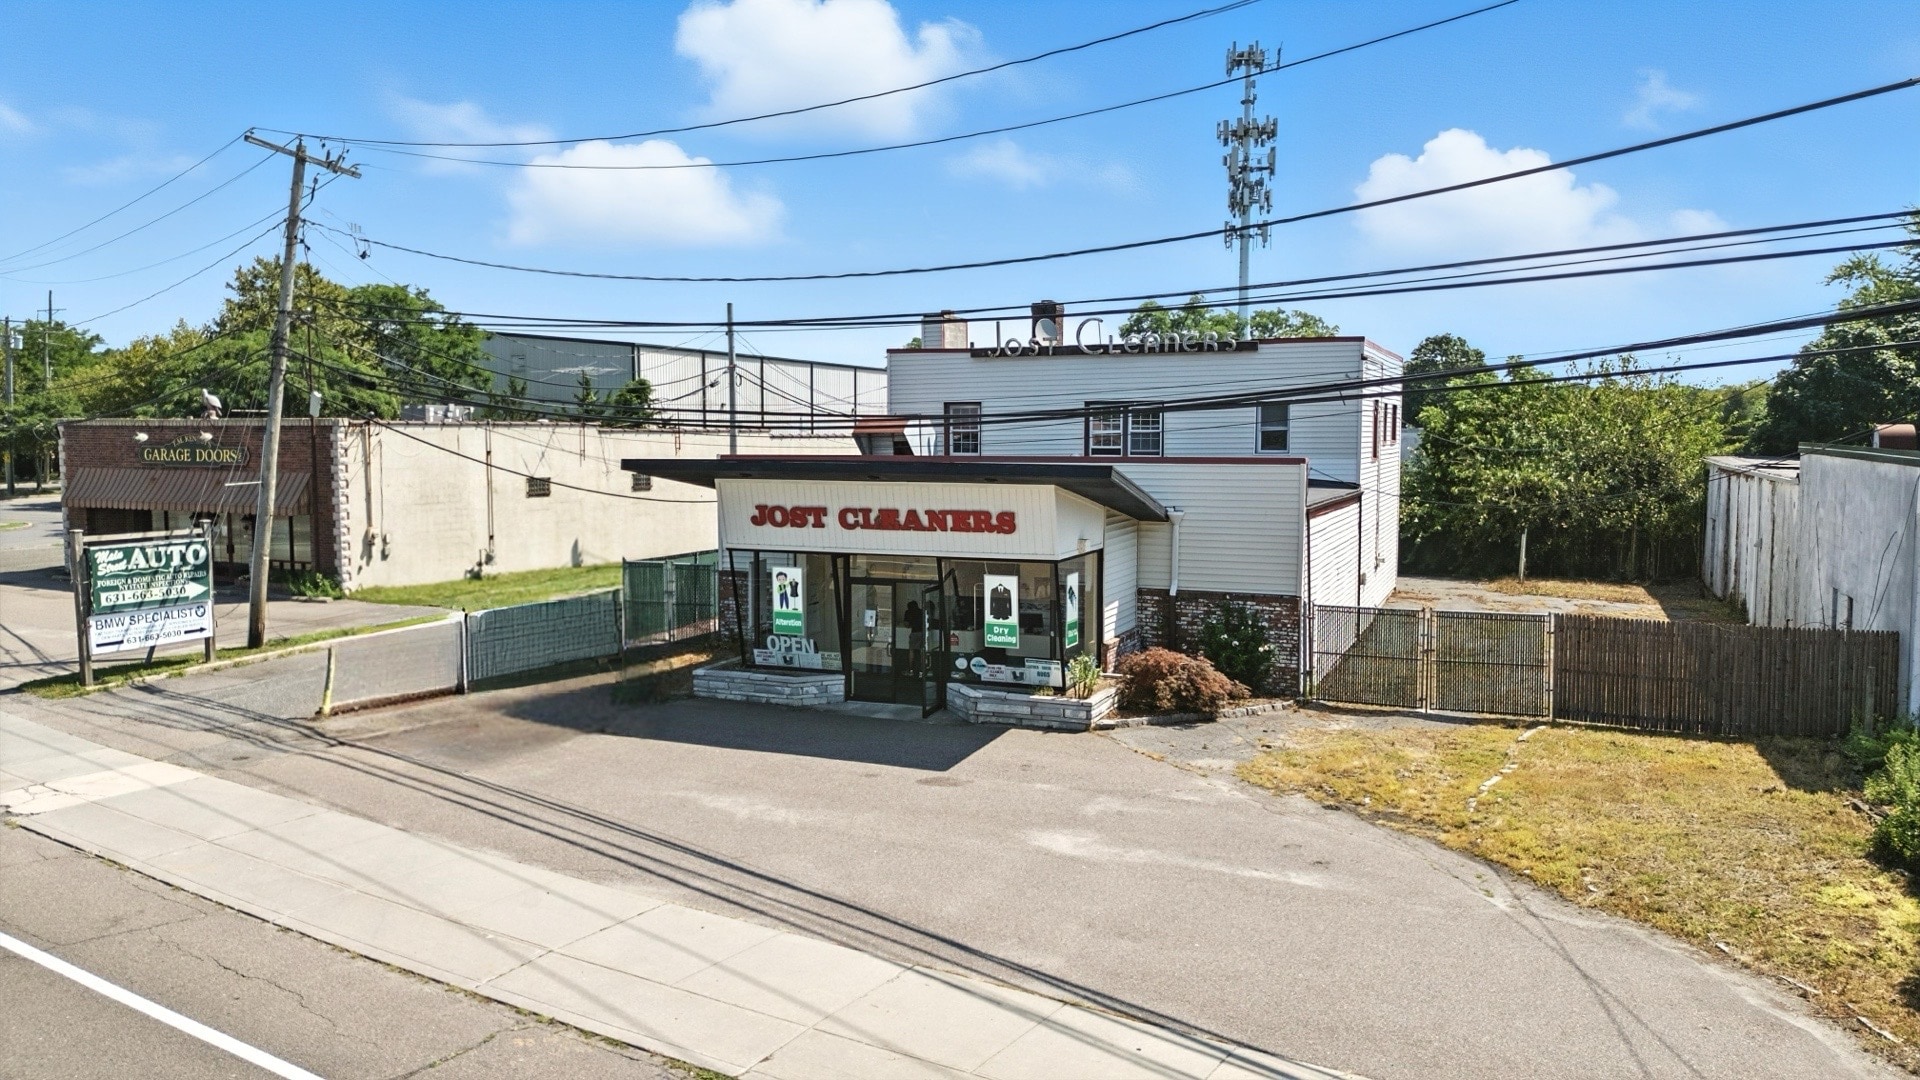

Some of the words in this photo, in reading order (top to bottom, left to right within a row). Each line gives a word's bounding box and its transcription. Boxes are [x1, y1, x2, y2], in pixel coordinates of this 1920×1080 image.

[144, 448, 191, 462] GARAGE
[196, 448, 238, 462] DOORS
[750, 504, 828, 529] JOST
[838, 507, 1017, 535] CLEANERS
[128, 544, 207, 570] AUTO
[96, 577, 126, 589] FOREIGN
[105, 586, 187, 604] 631-663-5030
[95, 616, 126, 631] BMW
[129, 608, 193, 626] SPECIALIST
[126, 630, 182, 644] 631-663-5030
[993, 626, 1009, 634] Dry
[766, 635, 815, 655] OPEN
[987, 634, 1017, 643] Cleaning
